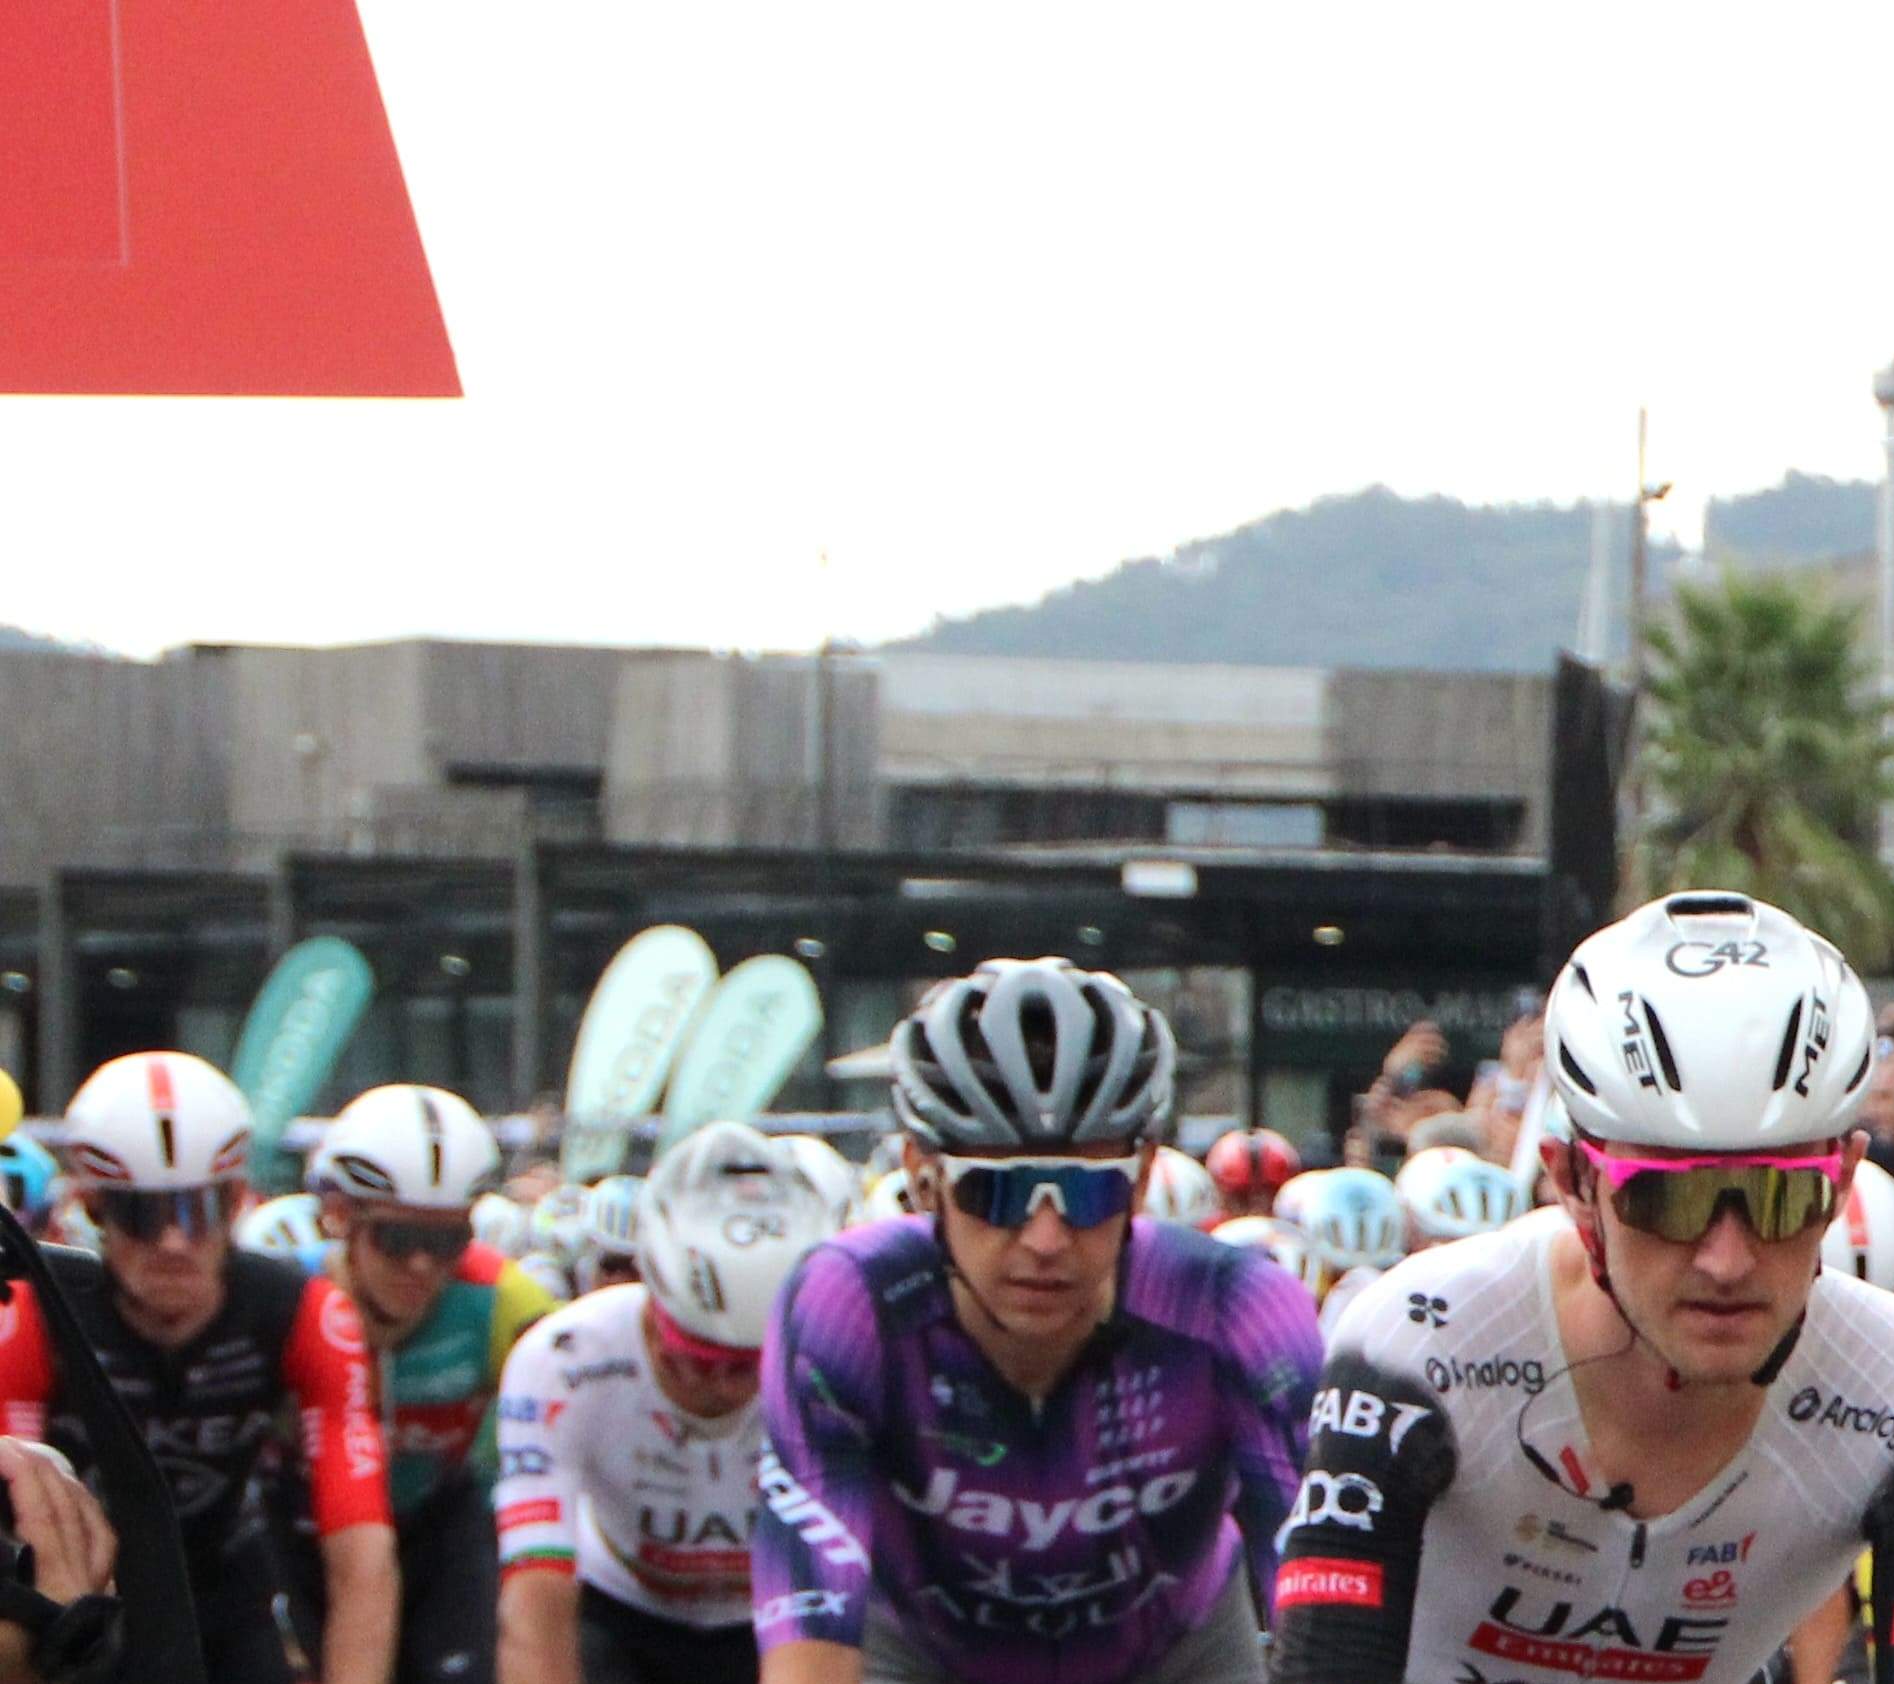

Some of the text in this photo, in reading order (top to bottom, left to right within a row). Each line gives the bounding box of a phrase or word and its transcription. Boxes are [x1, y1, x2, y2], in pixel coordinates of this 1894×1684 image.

[1666, 941, 1770, 978] G42
[1618, 990, 1662, 1096] MET
[1795, 985, 1831, 1098] MET
[637, 1505, 760, 1545] UA
[890, 1467, 1198, 1551] Jayco
[1488, 1586, 1729, 1653] UAE
